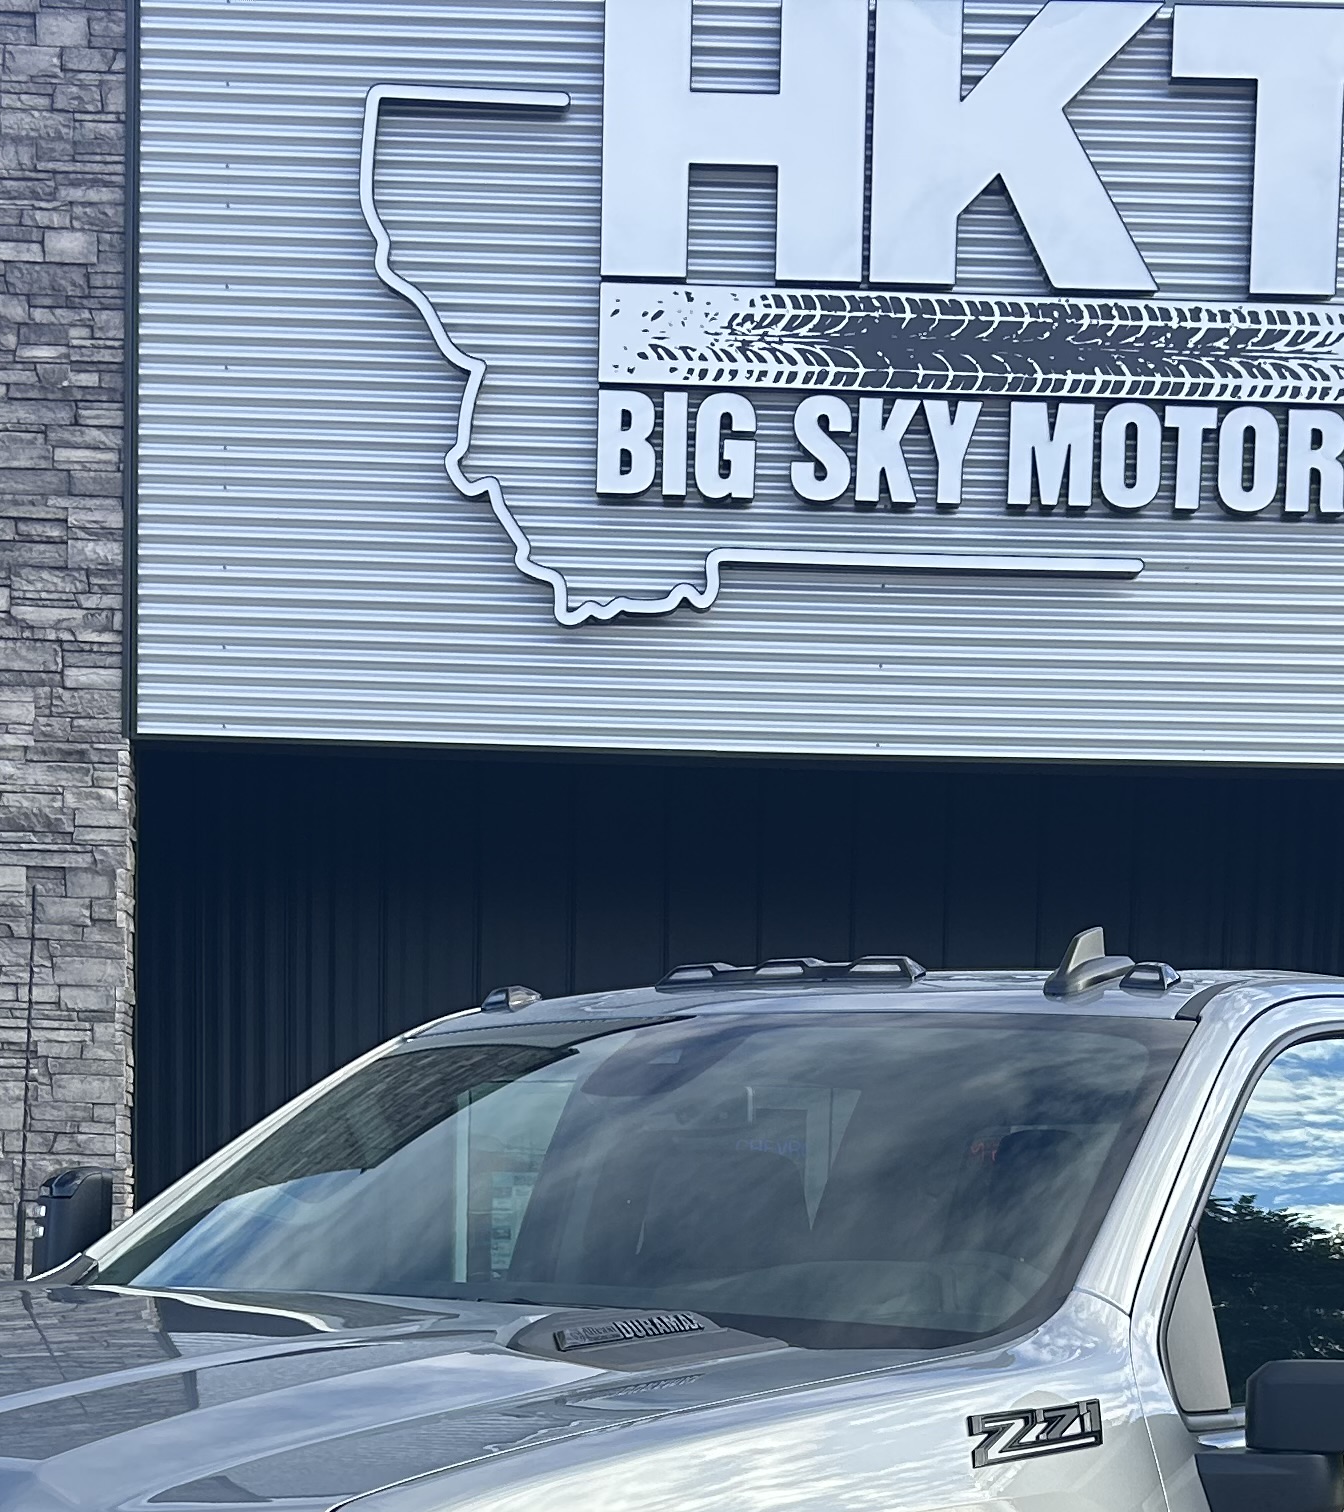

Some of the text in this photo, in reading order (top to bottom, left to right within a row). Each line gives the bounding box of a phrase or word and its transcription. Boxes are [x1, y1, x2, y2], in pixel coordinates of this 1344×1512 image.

[595, 389, 758, 503] BIG
[788, 393, 984, 507] SKY
[612, 1312, 705, 1340] DURAMAX
